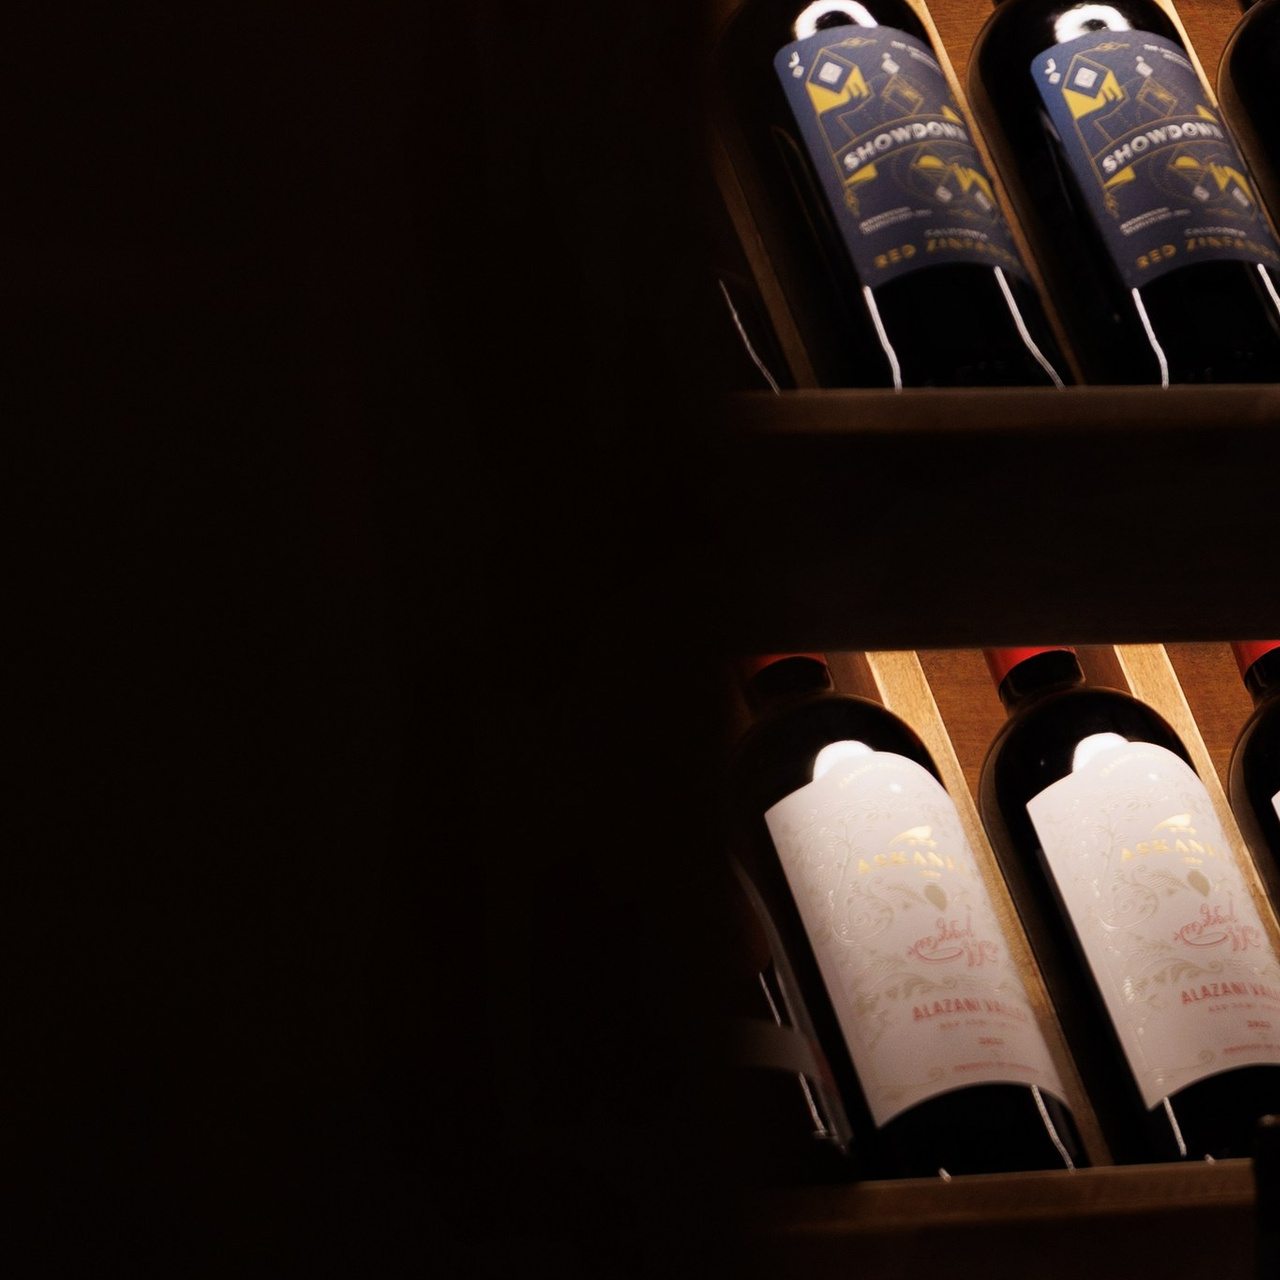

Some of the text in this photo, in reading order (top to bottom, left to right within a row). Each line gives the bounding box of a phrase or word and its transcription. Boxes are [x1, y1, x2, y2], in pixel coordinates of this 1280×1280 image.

[842, 120, 968, 172] SHOWDOWN
[1101, 121, 1224, 175] SHOWDOWN
[1135, 243, 1177, 270] RED
[1181, 982, 1247, 1006] ALAZANI
[912, 998, 984, 1020] ALAZANI
